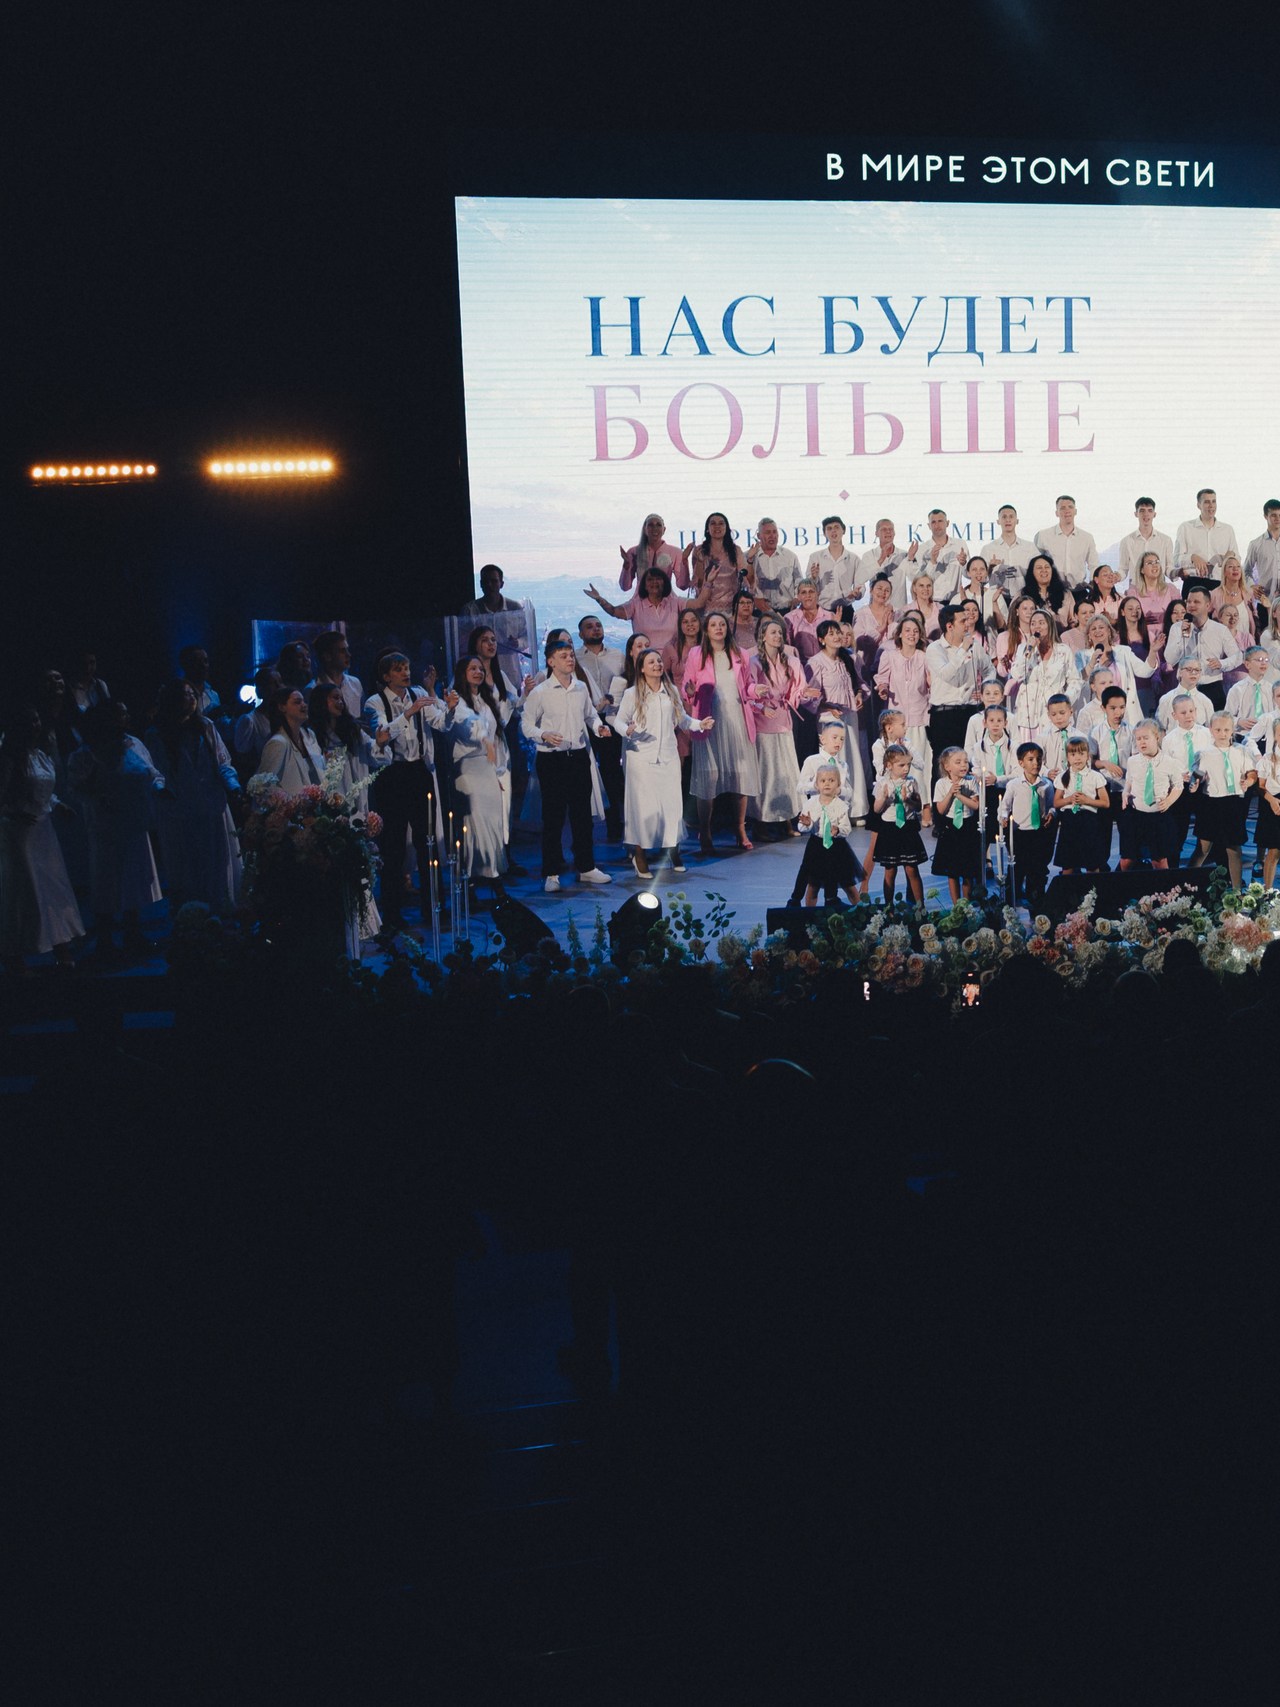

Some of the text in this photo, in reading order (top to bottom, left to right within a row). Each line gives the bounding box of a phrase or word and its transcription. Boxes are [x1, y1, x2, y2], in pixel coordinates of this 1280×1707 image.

[826, 153, 1214, 188] В МИРЕ ЭТОМ СВЕТИ
[583, 294, 1092, 367] НАС БУДЕТ
[585, 379, 1096, 462] БОЛЬШЕ
[849, 524, 881, 544] Н
[908, 521, 997, 543] КМН
